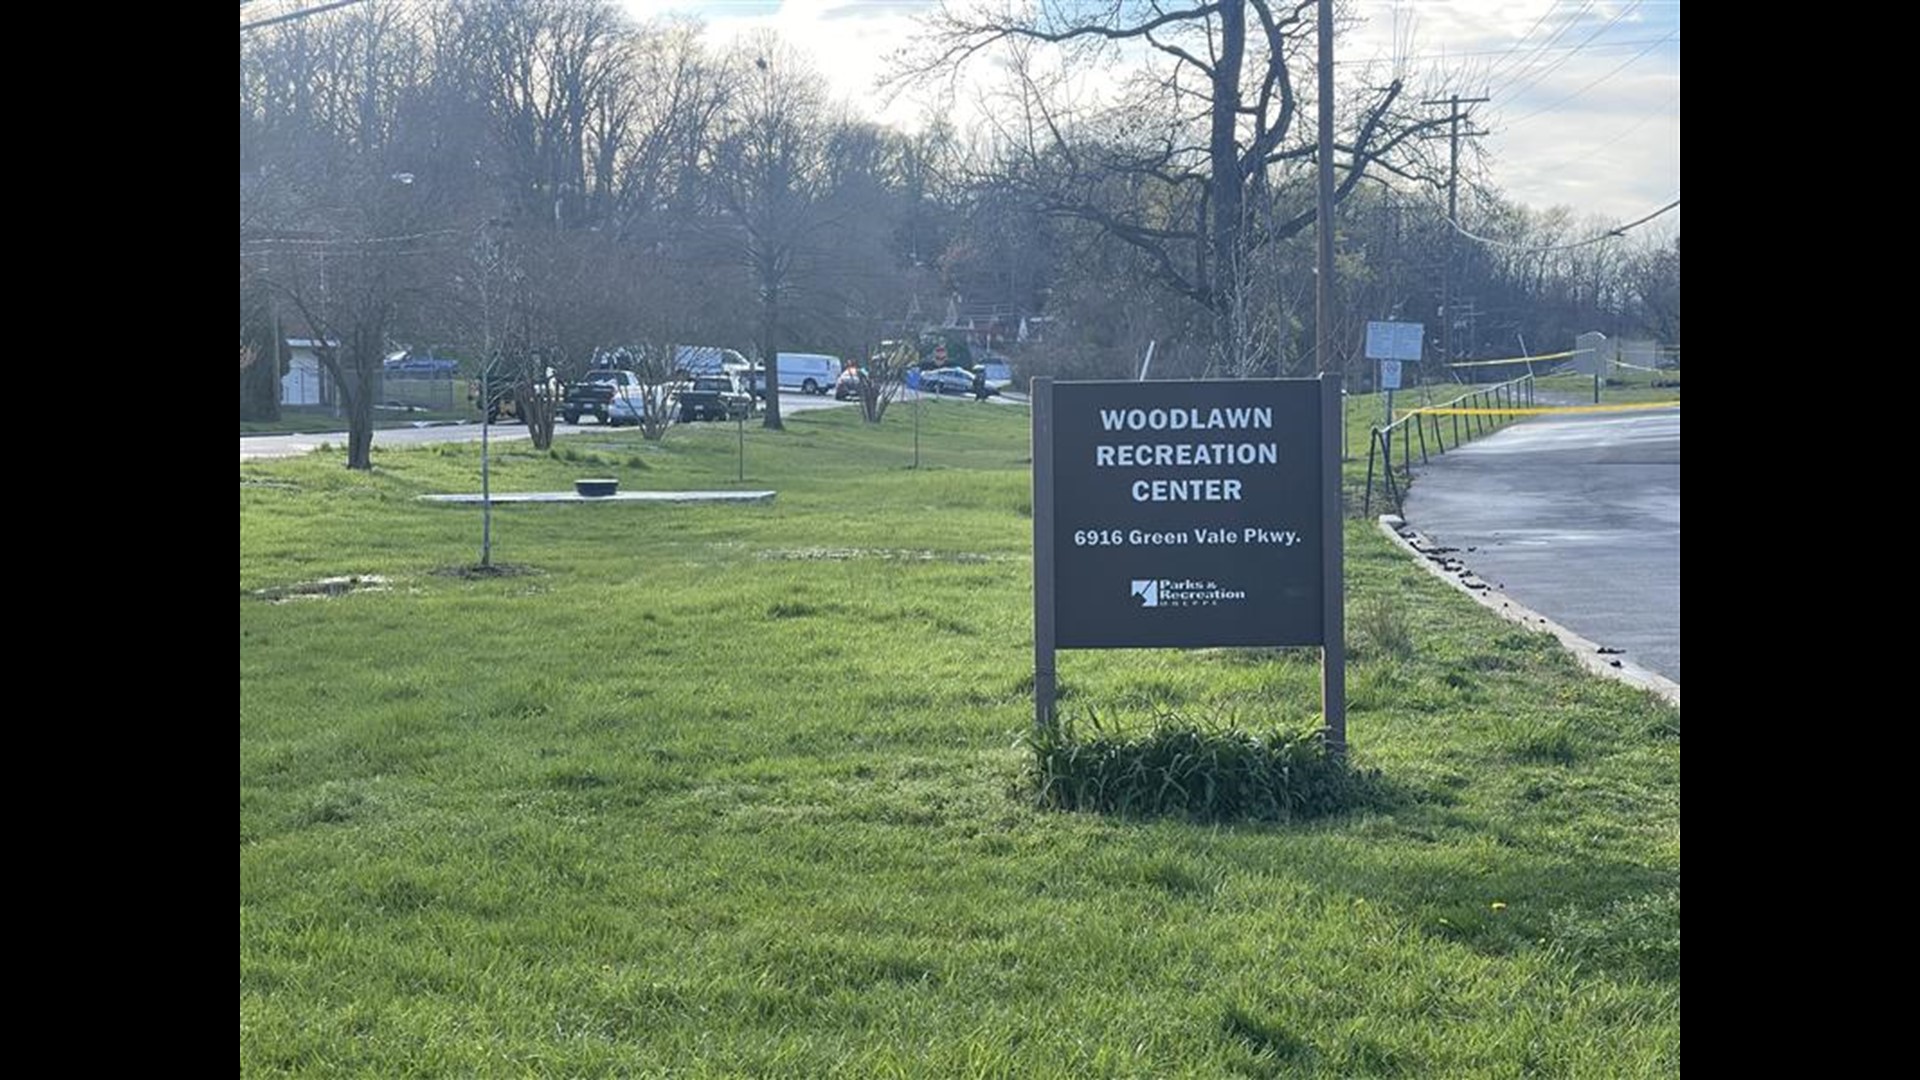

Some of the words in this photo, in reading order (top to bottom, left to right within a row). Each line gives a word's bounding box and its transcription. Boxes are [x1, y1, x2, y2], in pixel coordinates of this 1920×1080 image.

[1100, 408, 1272, 430] WOODLAWN
[1096, 443, 1277, 466] RECREATION
[1132, 479, 1242, 502] CENTER
[1074, 530, 1123, 546] 6916
[1129, 529, 1188, 545] Green
[1194, 528, 1238, 544] Vale
[1244, 527, 1301, 547] Pkwy.
[1159, 579, 1204, 590] Parks
[1159, 588, 1246, 600] Recreation
